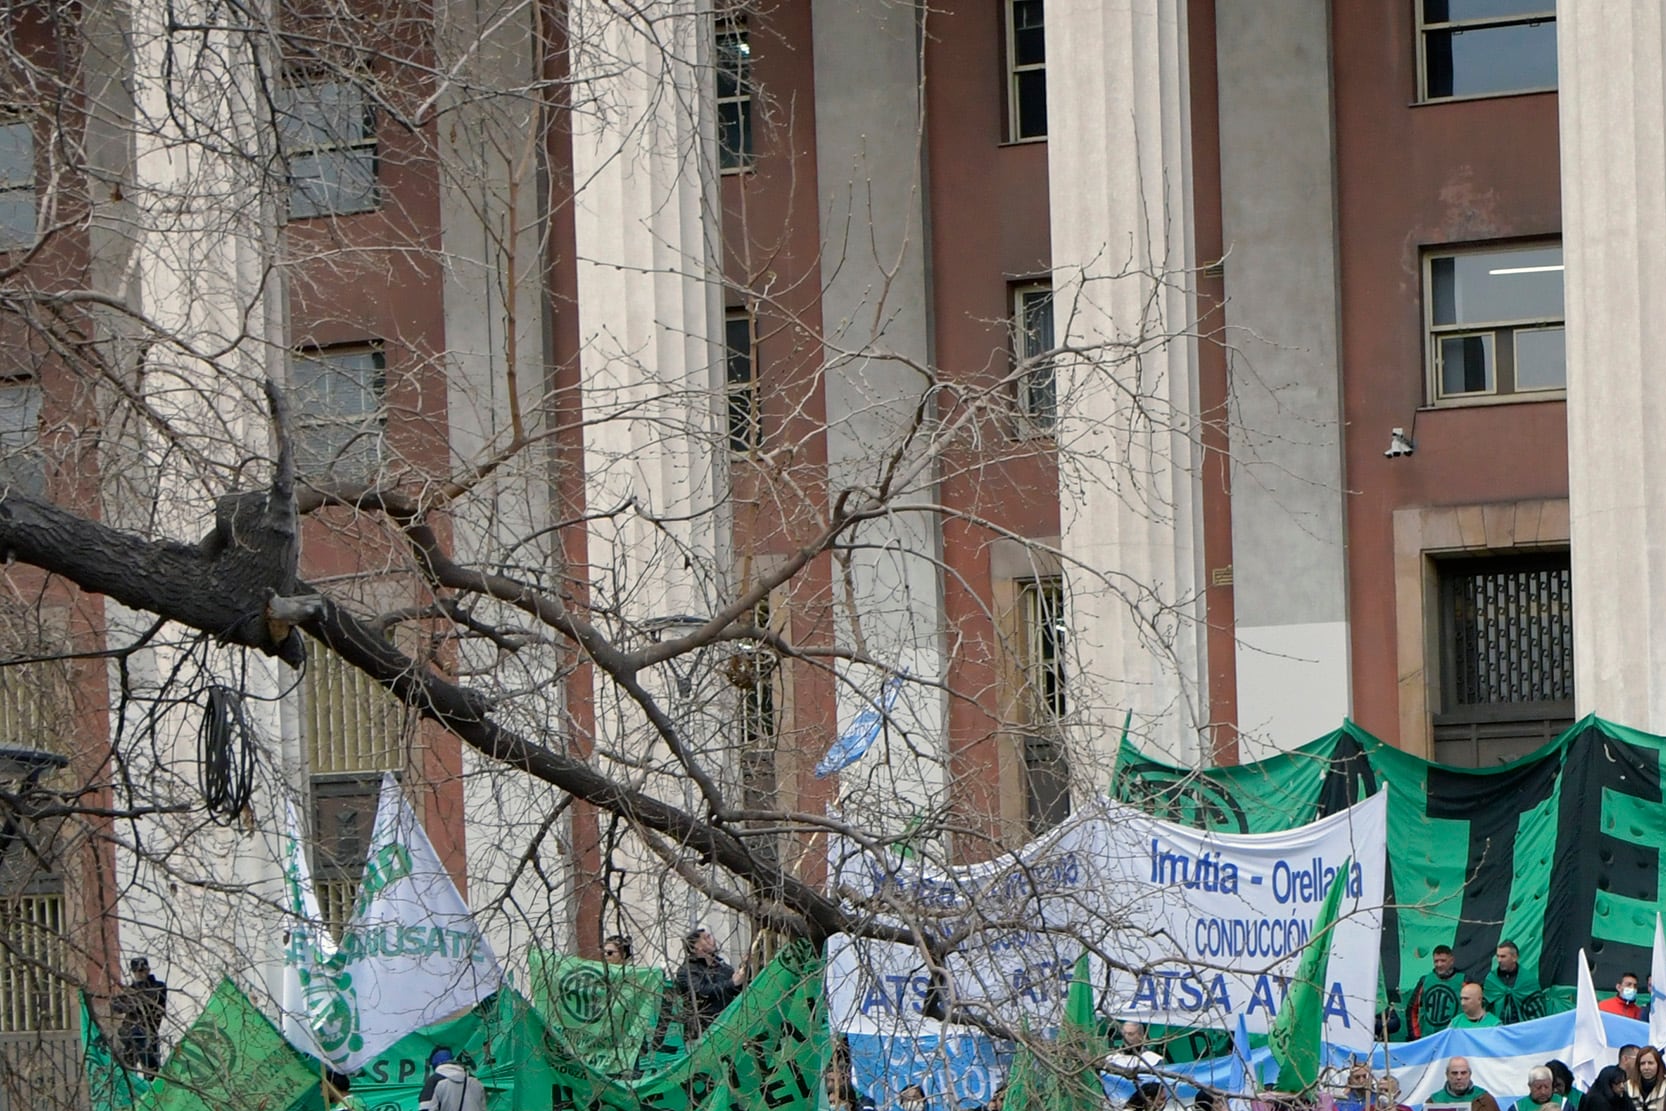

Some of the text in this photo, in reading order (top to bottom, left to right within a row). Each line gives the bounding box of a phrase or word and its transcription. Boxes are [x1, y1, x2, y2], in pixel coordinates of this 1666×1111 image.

[1150, 838, 1239, 895] Irrutia
[1195, 908, 1313, 958] CONDUCCIÓN
[1130, 970, 1351, 1029] ATSA ATA
